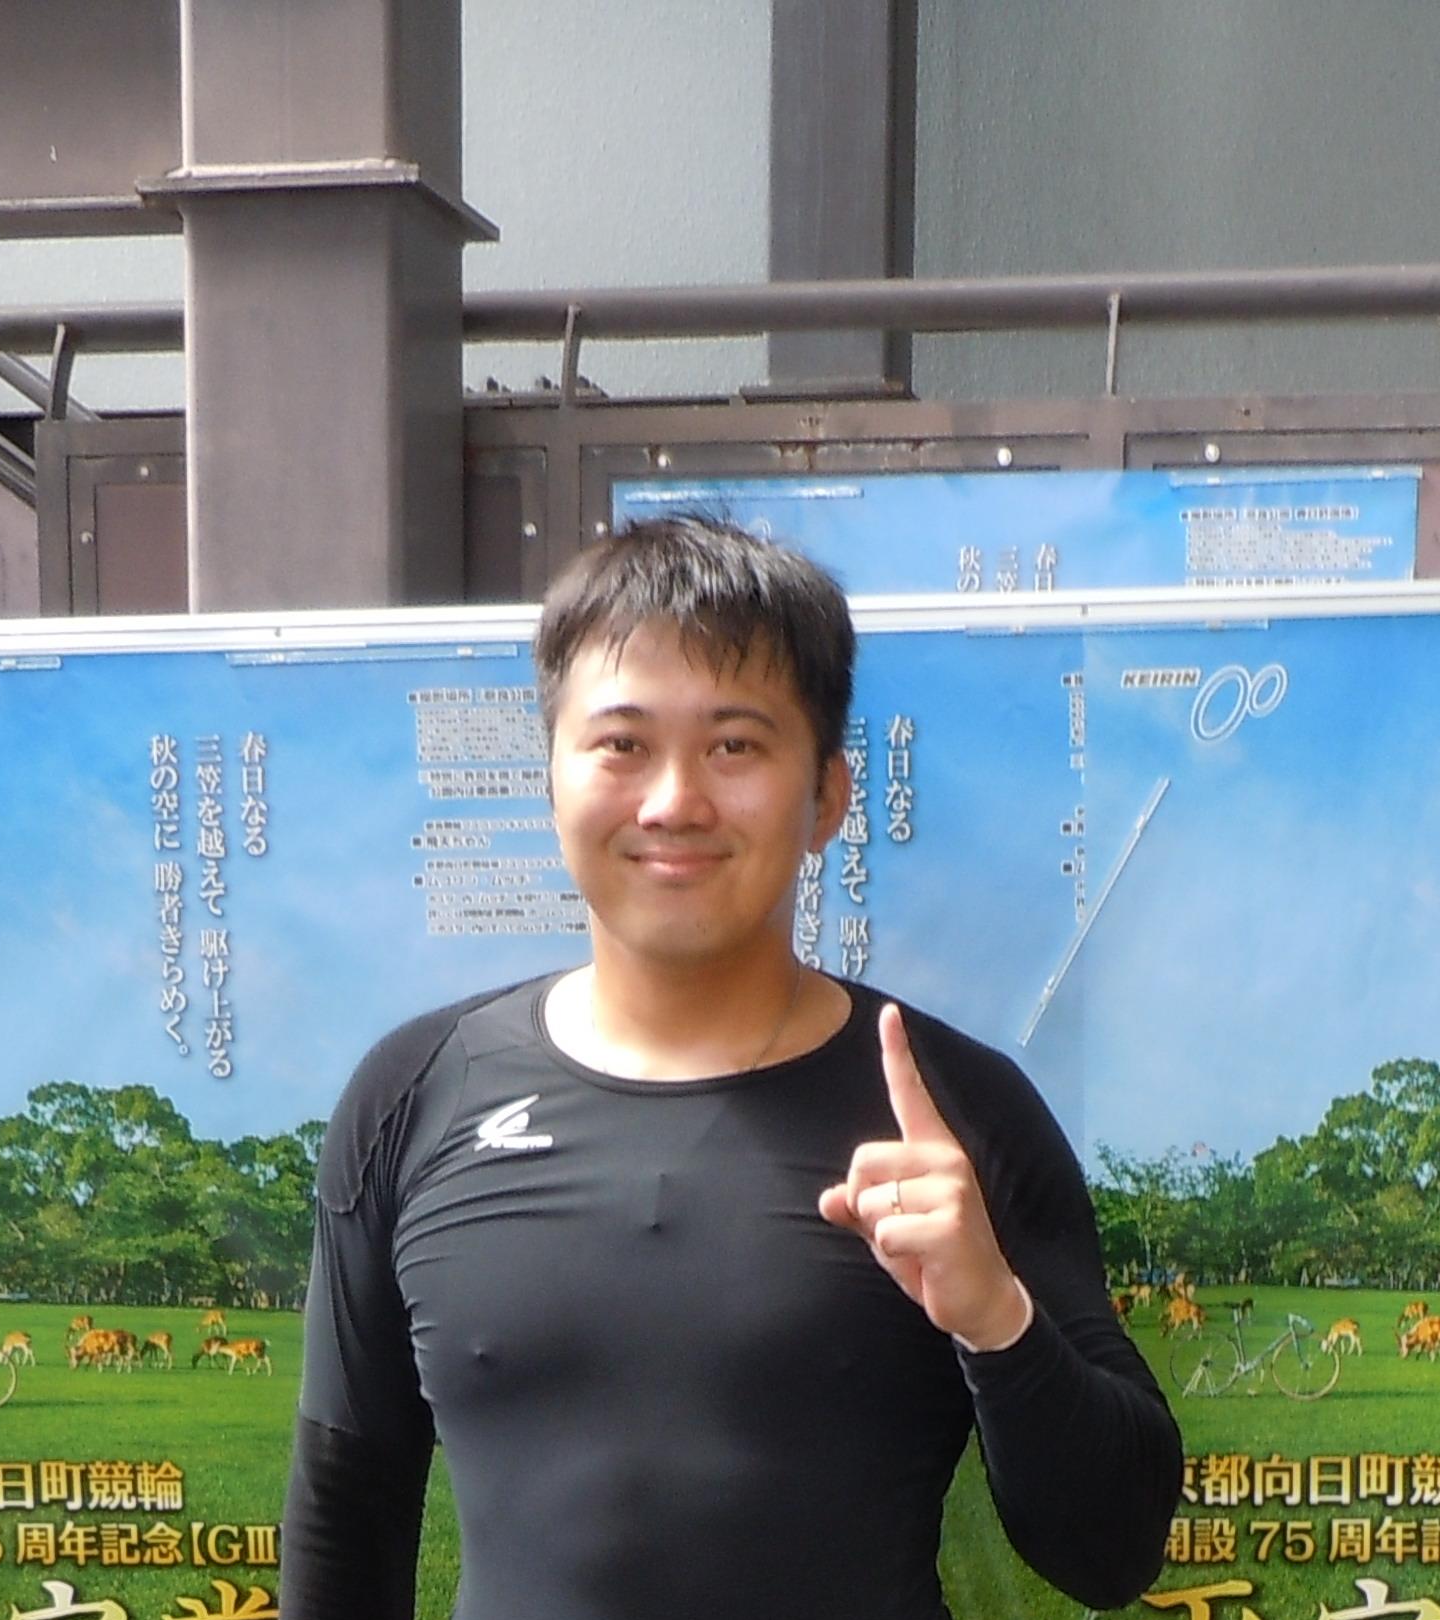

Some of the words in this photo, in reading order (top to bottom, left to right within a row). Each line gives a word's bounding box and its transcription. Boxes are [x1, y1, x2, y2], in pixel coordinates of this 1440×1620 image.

[1122, 671, 1198, 687] KEIRIN
[150, 734, 181, 850] 秋の空に
[195, 734, 227, 917] 三笠を越えて
[239, 731, 269, 857] 春日なる
[885, 714, 915, 843] 春日なる
[154, 863, 189, 1056] 勝者きらめく。
[199, 928, 234, 1080] 駆け上がる
[1249, 1520, 1314, 1562] 75
